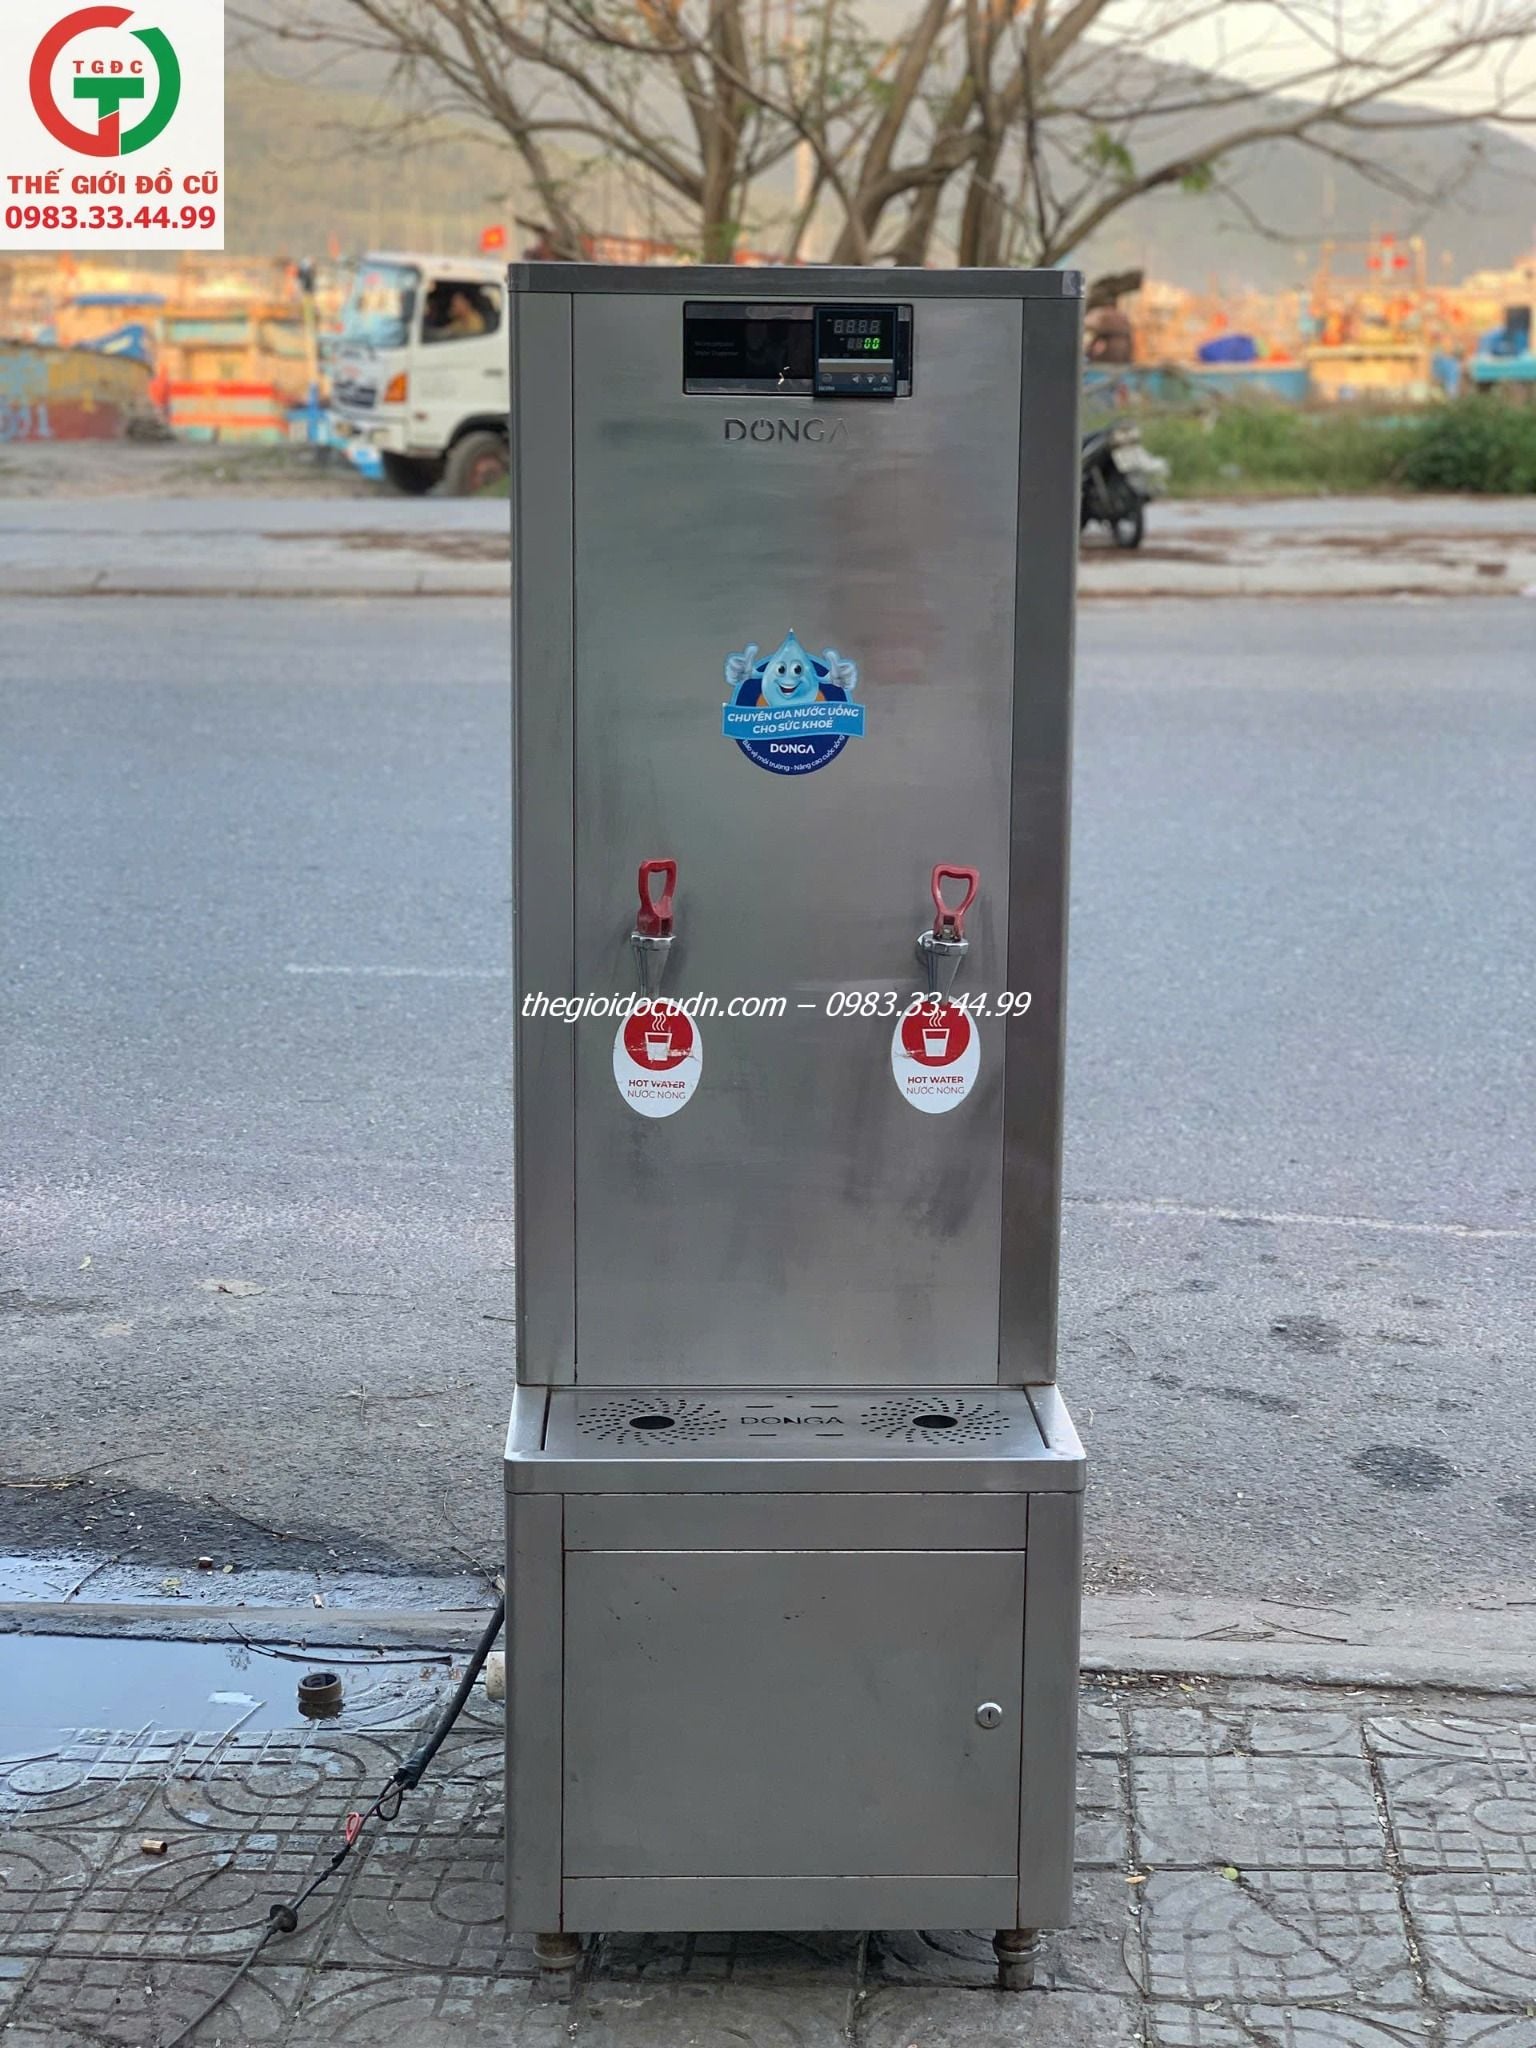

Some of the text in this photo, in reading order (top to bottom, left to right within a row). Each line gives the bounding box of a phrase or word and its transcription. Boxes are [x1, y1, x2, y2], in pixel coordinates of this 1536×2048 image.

[724, 418, 850, 443] DONGA
[728, 704, 859, 722] CHUYÊN GIA NƯỚC UỐNG
[753, 724, 777, 734] CHO
[778, 721, 800, 732] SỨC
[770, 743, 815, 754] DONGA
[628, 1079, 686, 1089] HOT WATER
[908, 1076, 964, 1084] HOT WATER
[741, 1416, 844, 1425] DONGA
